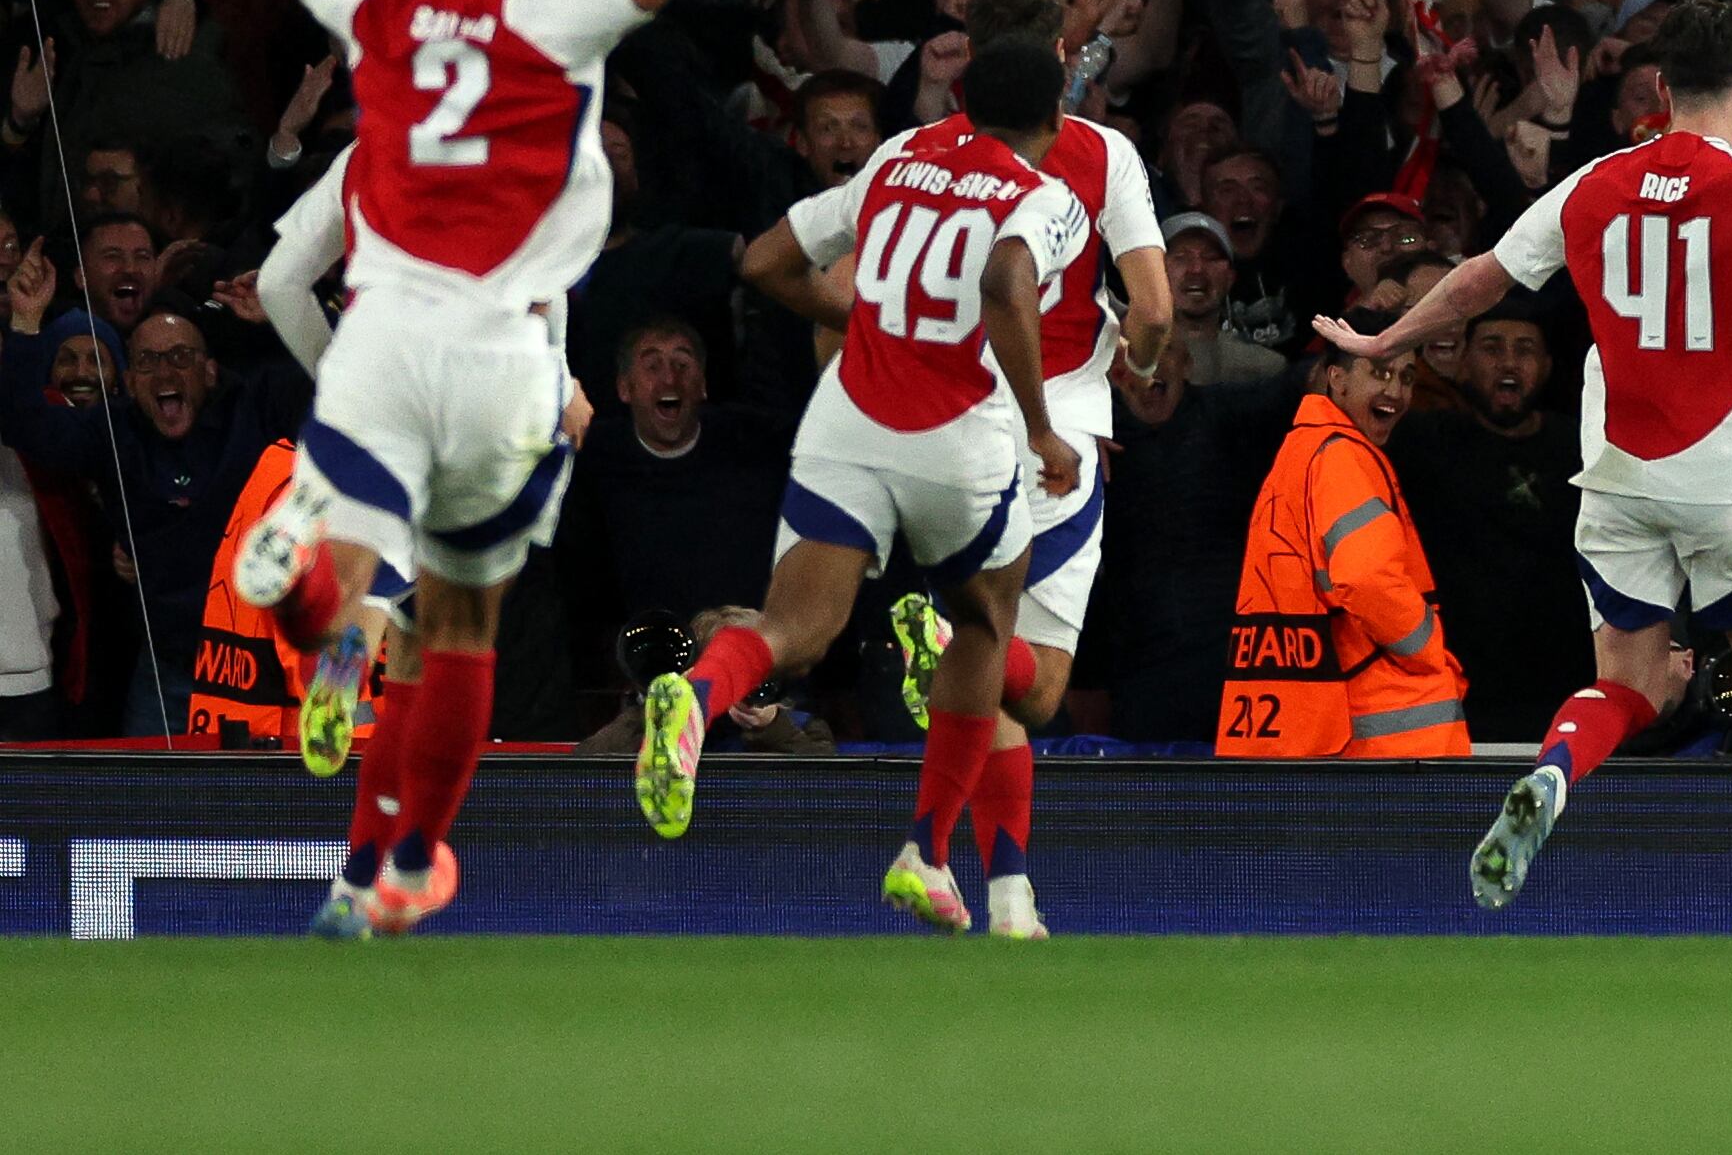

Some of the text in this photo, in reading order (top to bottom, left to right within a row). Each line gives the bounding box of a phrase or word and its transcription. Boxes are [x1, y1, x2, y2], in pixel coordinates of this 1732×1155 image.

[410, 41, 491, 166] 2
[1640, 172, 1690, 202] RICE
[855, 201, 996, 344] 49
[1602, 213, 1714, 351] 41
